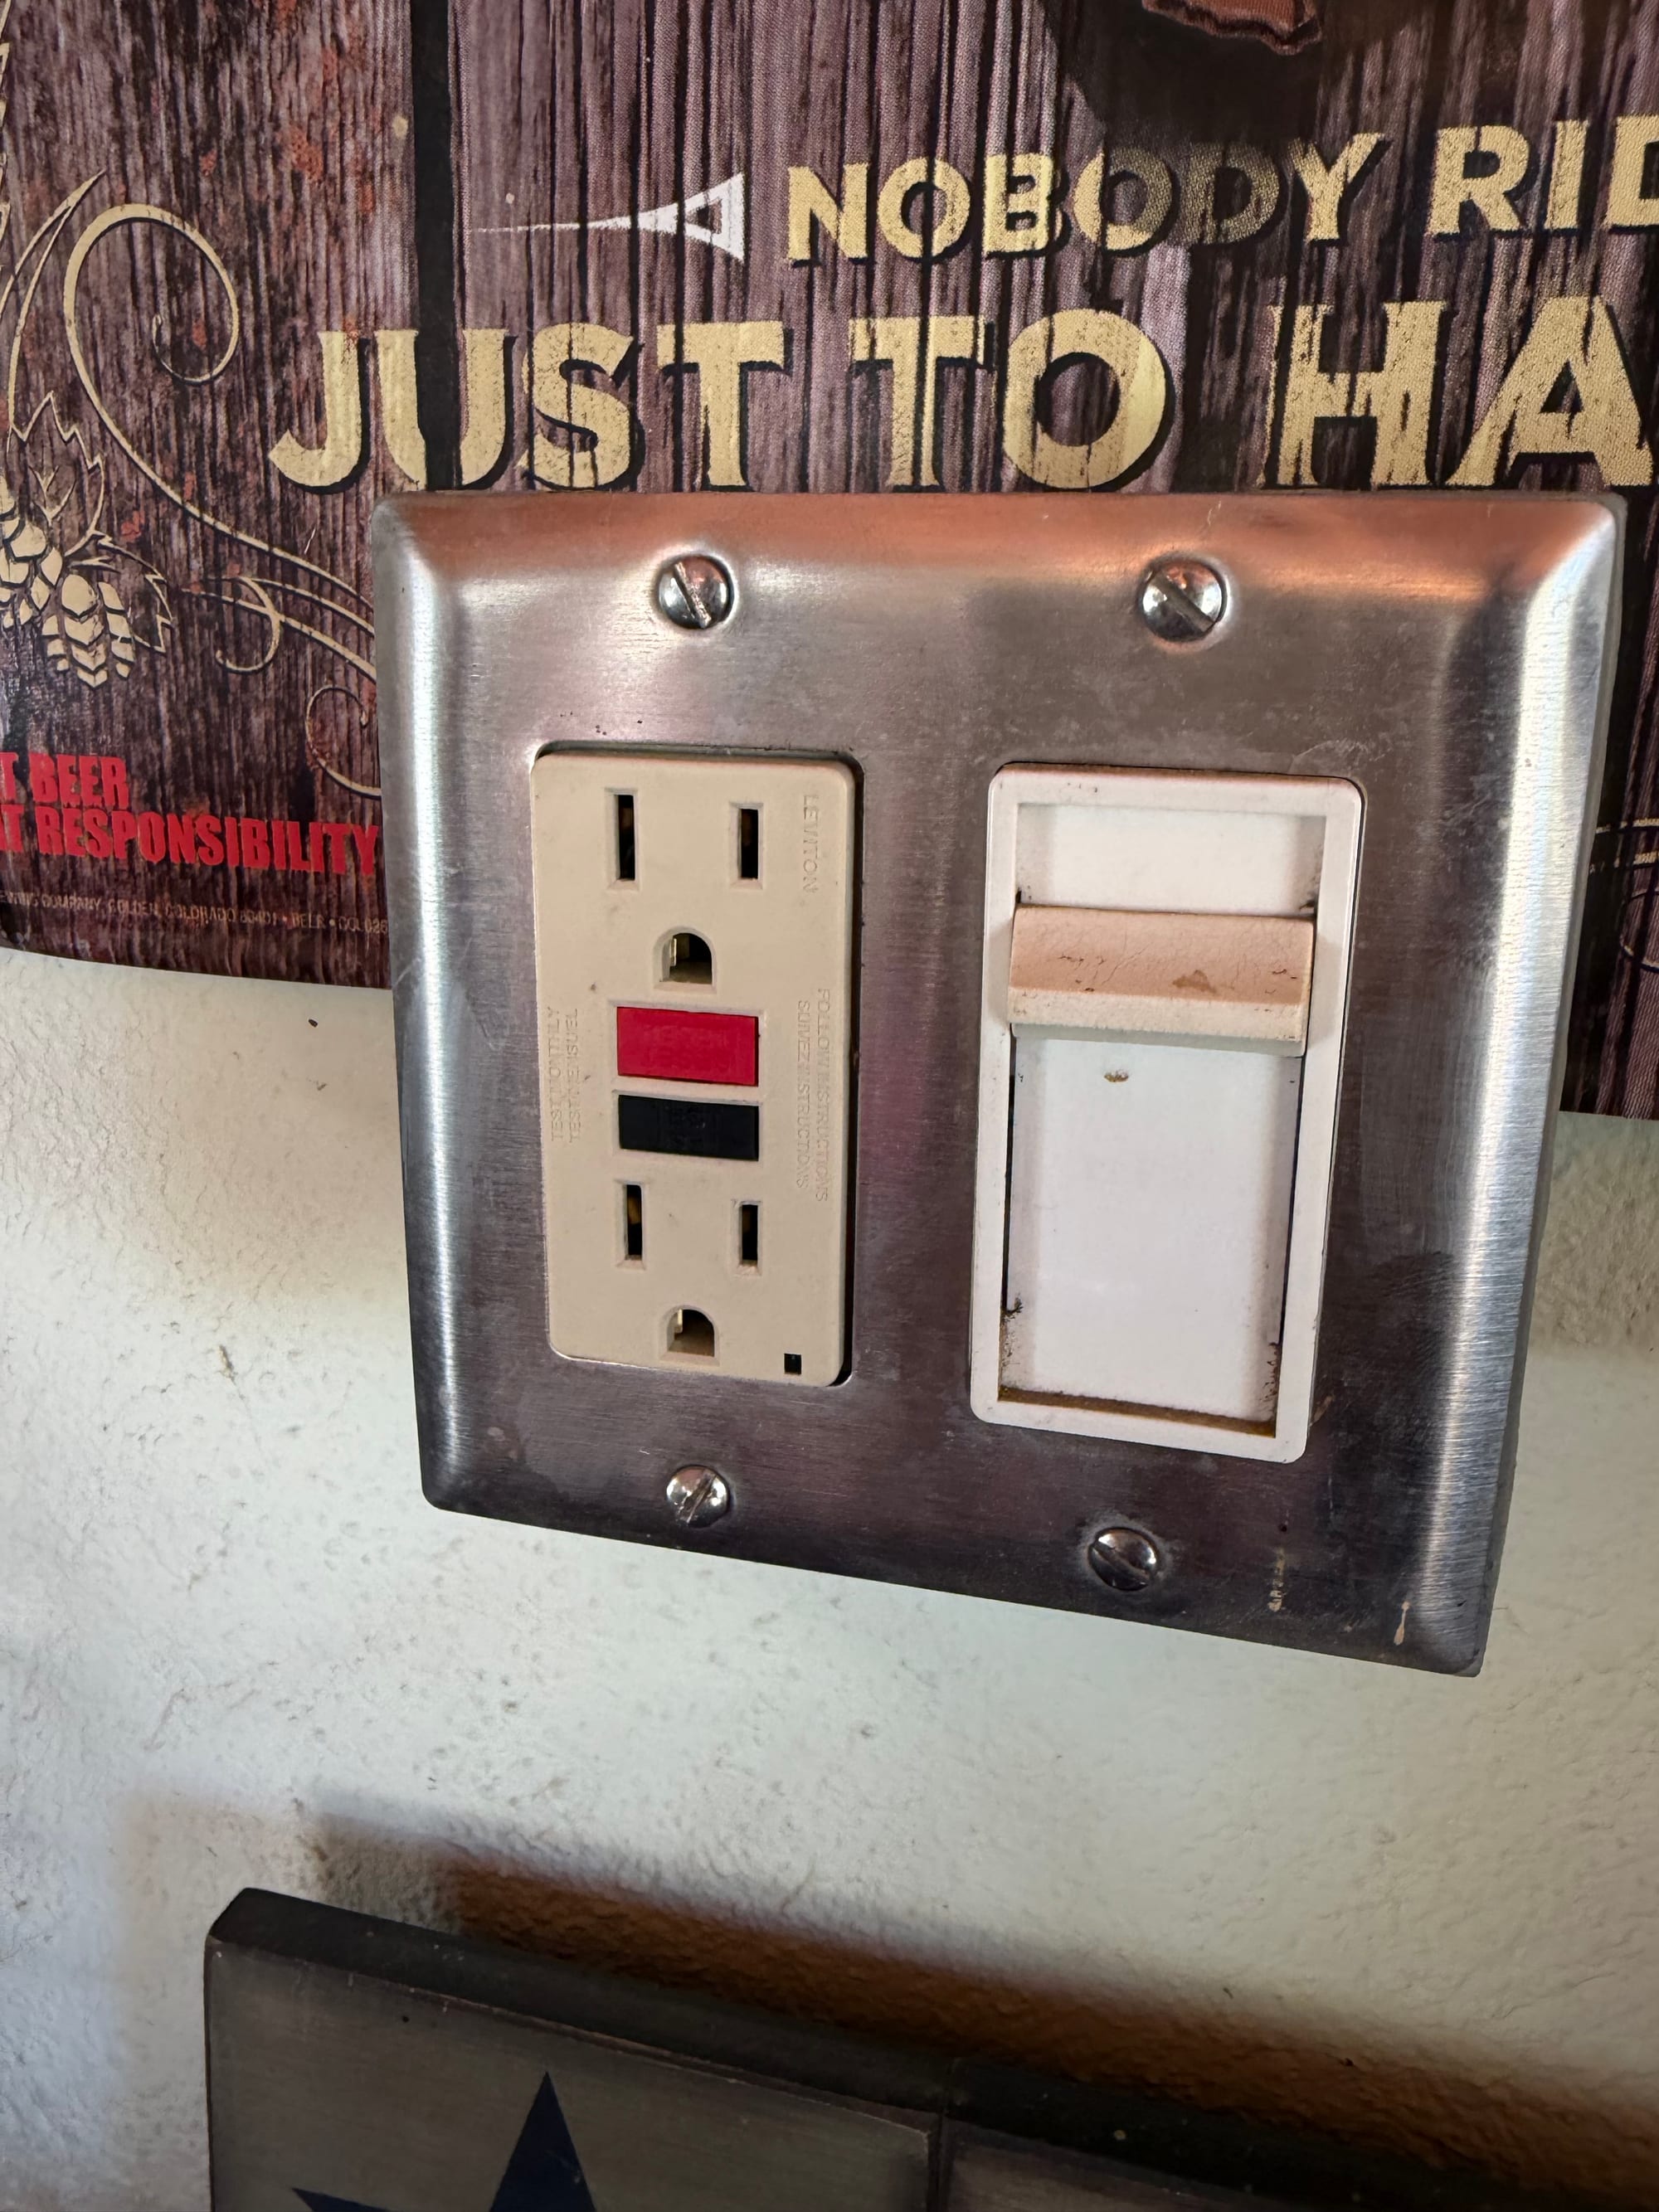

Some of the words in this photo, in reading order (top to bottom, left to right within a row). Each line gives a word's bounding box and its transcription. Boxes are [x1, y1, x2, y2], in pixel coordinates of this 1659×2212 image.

[786, 133, 1385, 260] NOBODY
[268, 320, 785, 491] JUST
[848, 309, 1168, 489] TO
[1258, 295, 1654, 489] HA
[29, 752, 129, 809] BEER
[35, 805, 379, 876] RESPONSIBILITY
[802, 795, 820, 893] LEVITON
